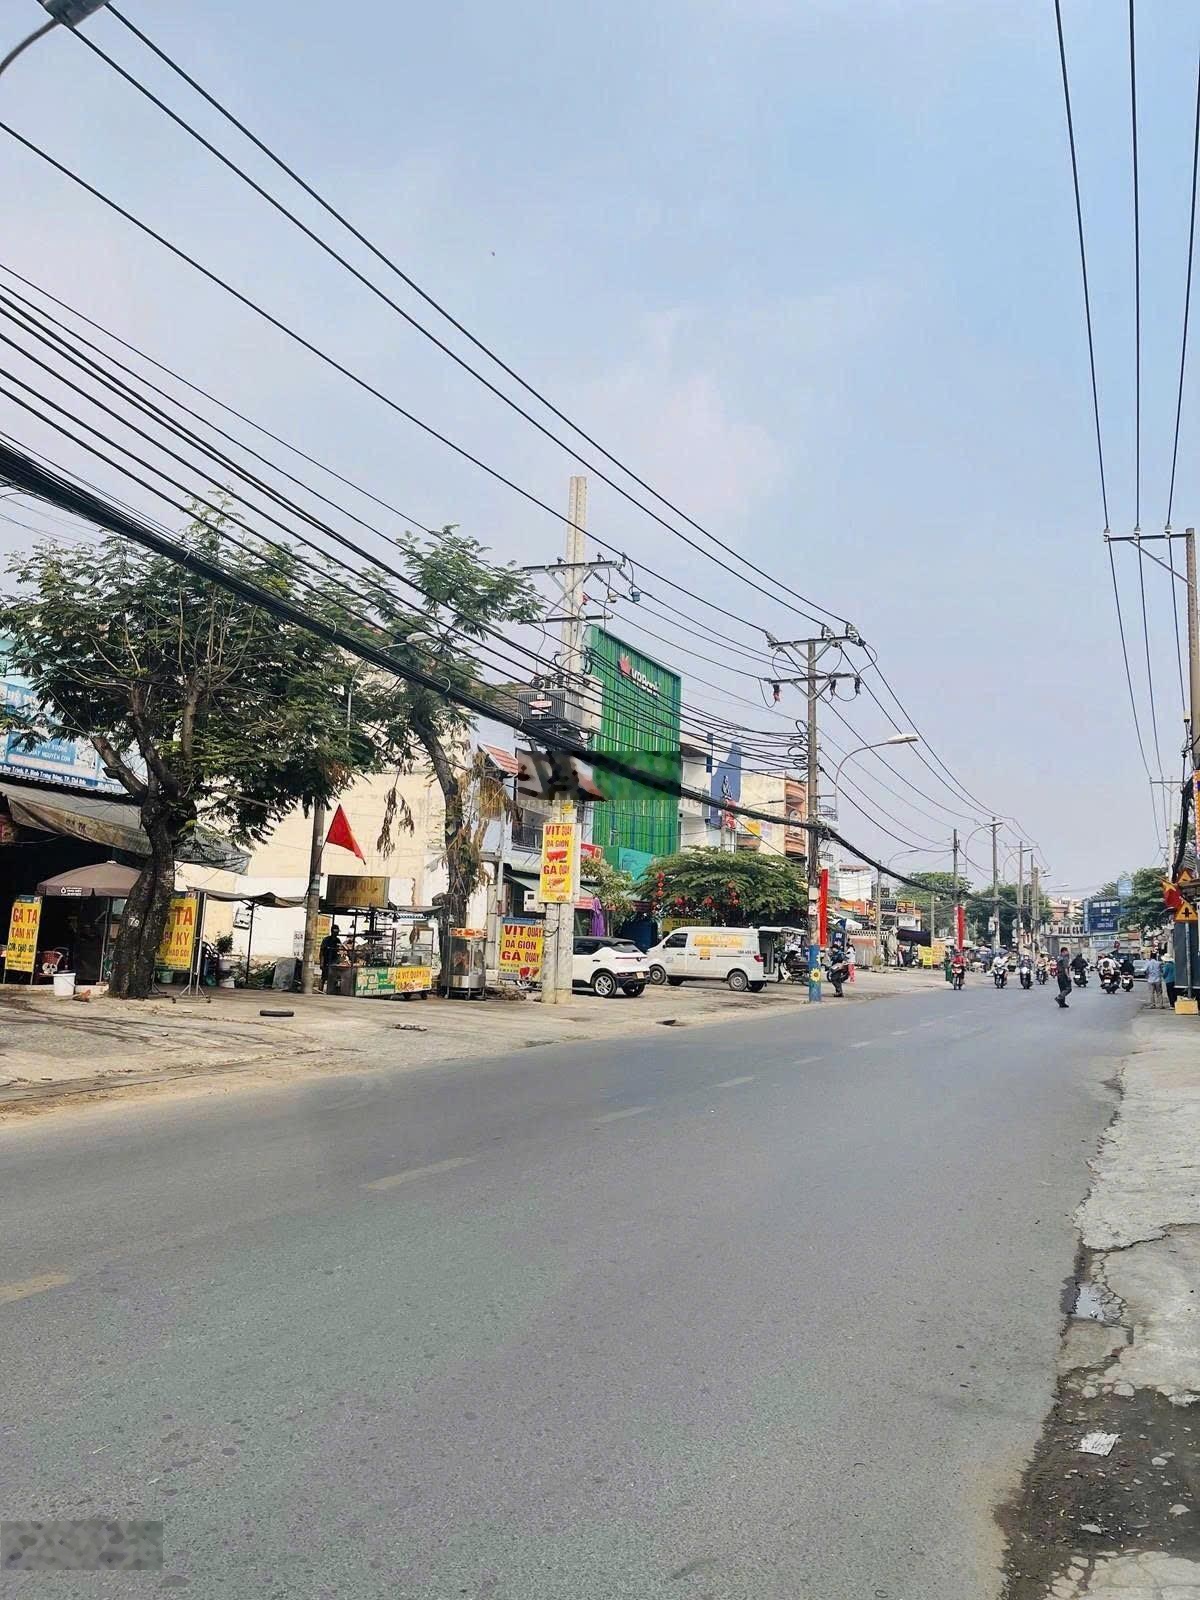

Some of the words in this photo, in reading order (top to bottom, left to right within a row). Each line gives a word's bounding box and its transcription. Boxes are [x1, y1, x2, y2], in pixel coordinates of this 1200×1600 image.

[631, 668, 660, 697] VPBank
[13, 904, 24, 923] GÀ
[27, 908, 37, 925] TA
[175, 906, 193, 926] TA
[504, 925, 526, 938] VỊT
[505, 940, 515, 948] DA
[501, 949, 522, 961] GÀ
